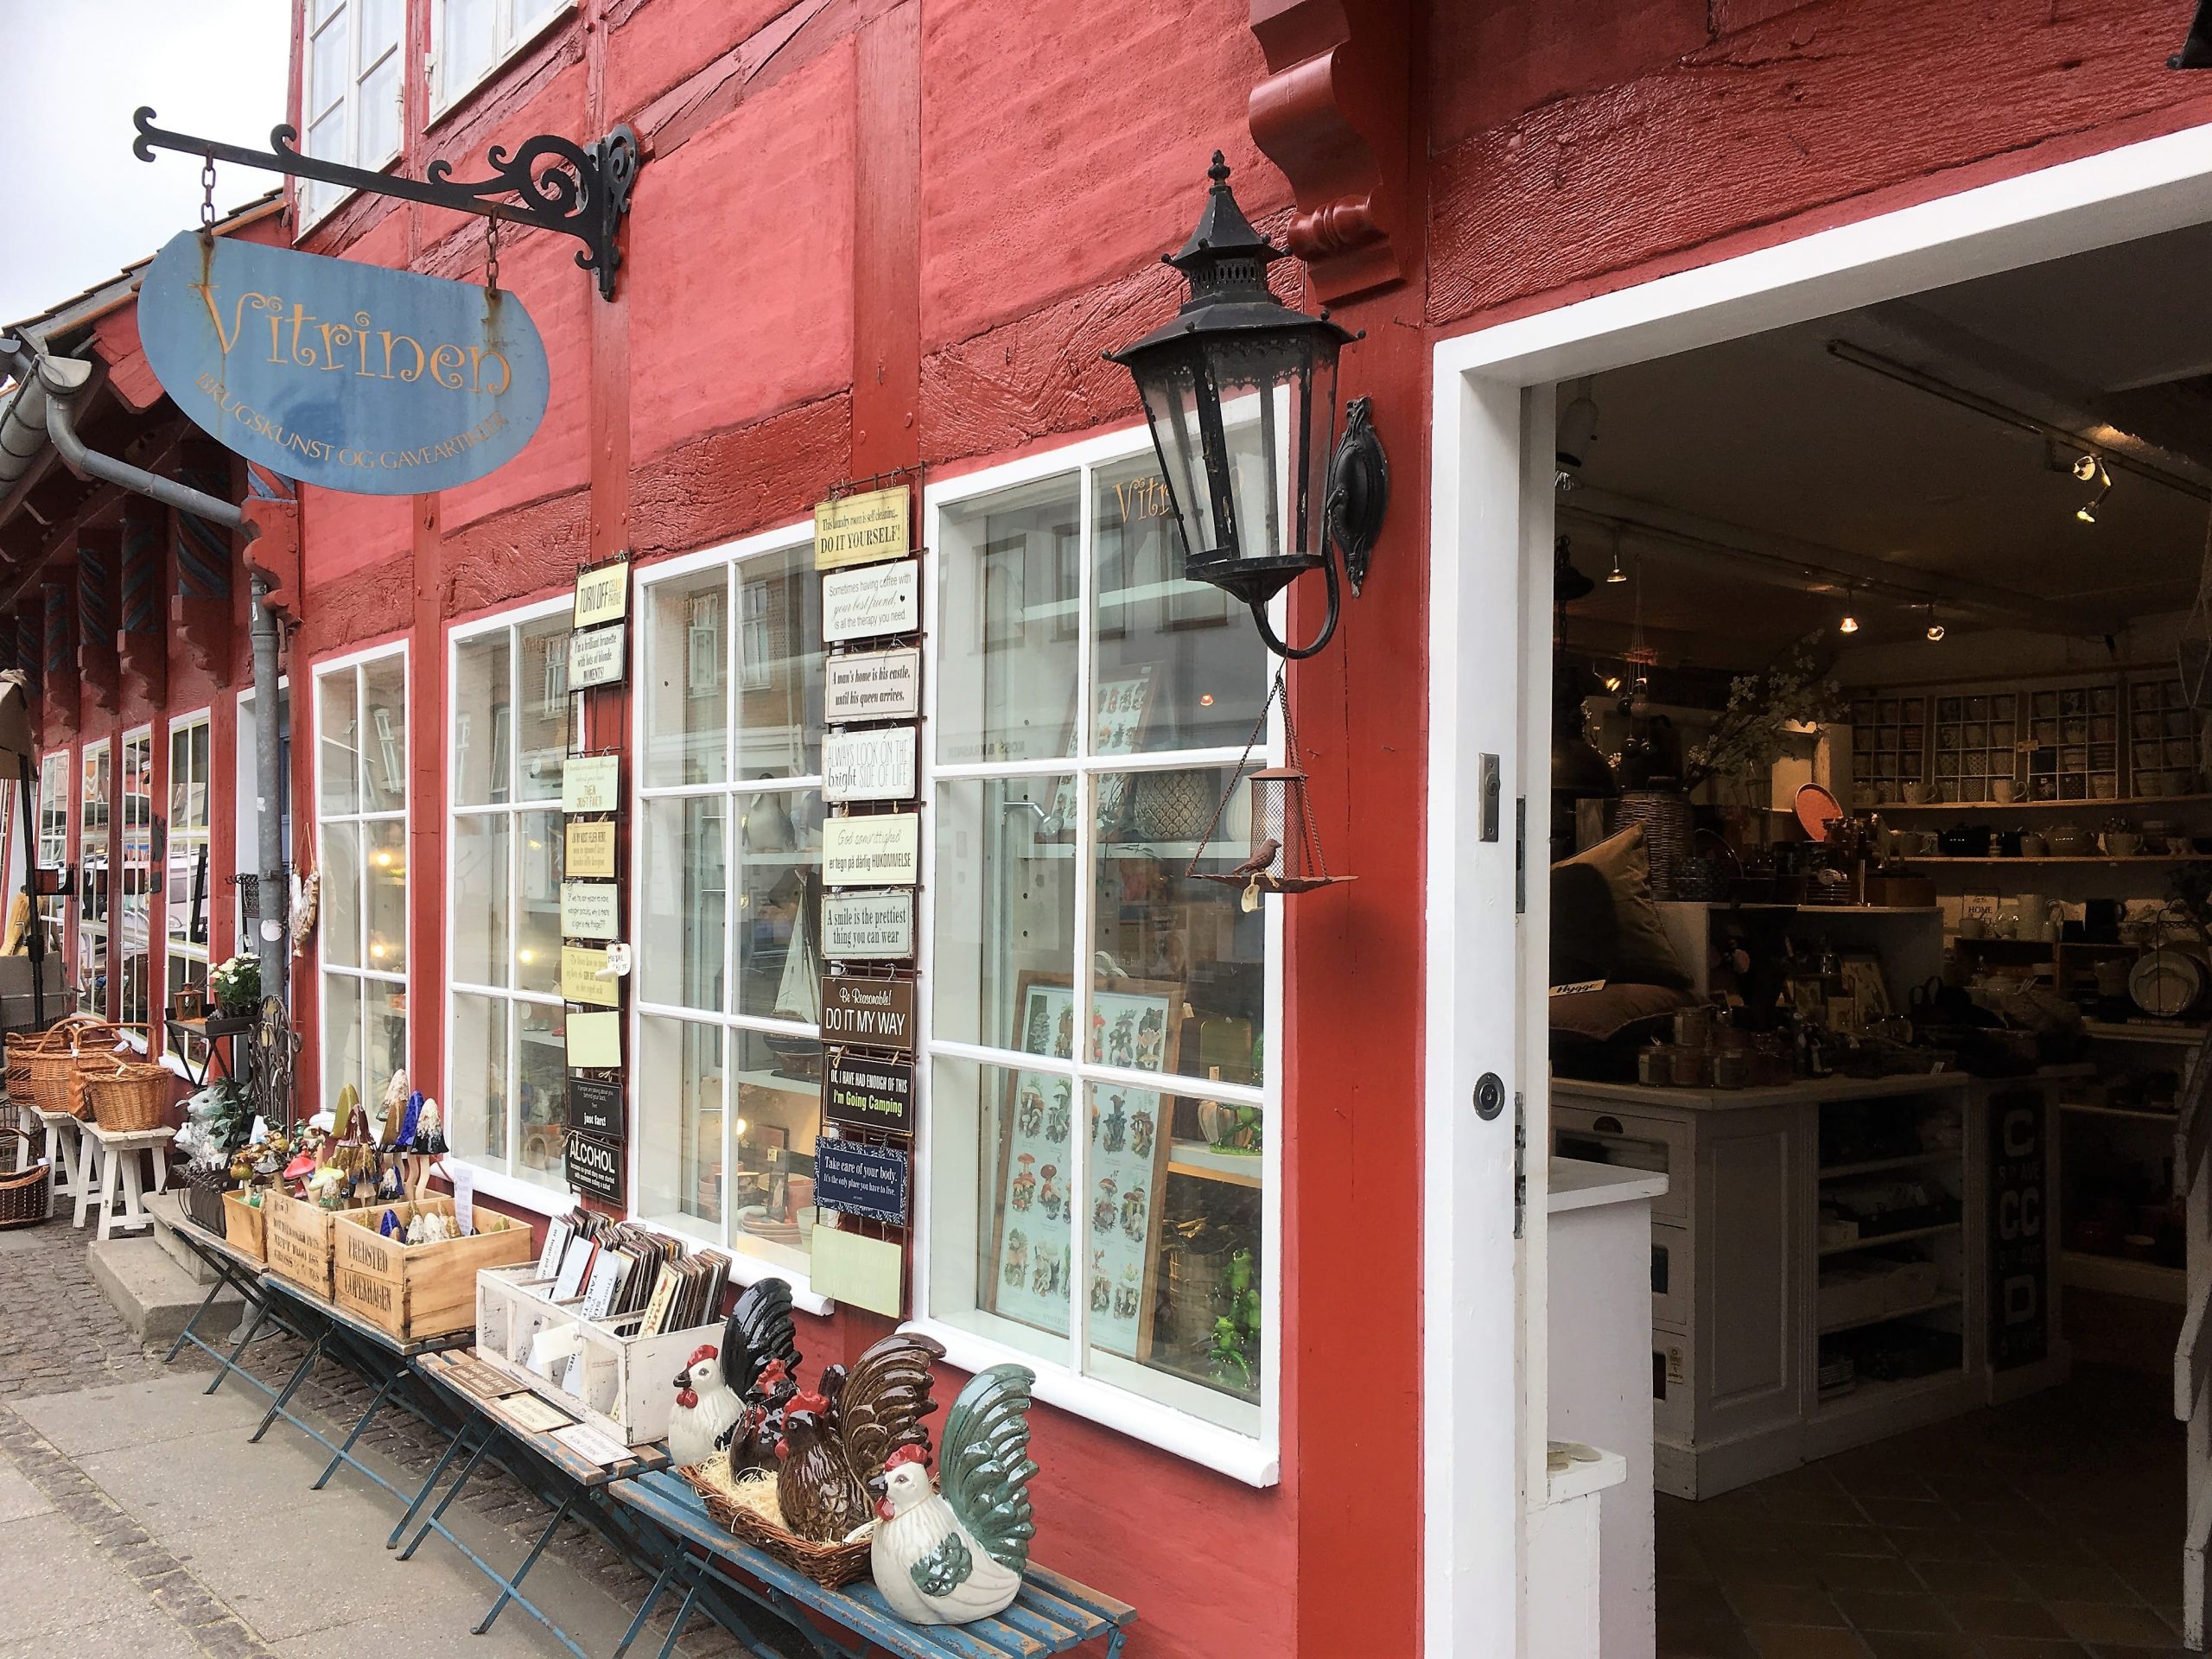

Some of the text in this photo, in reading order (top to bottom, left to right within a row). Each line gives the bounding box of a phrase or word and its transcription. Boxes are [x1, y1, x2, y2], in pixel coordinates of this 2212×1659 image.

[188, 283, 512, 397] Vitrinen
[195, 372, 509, 469] BRUGSKUNST OG GAVEARTIKLER
[867, 512, 876, 523] self
[821, 524, 900, 553] DO IT YOURSELF!
[596, 581, 609, 611] OFF
[830, 573, 911, 597] Sometimes having coffee with
[833, 604, 853, 622] your
[835, 619, 840, 630] is
[847, 616, 856, 628] the
[856, 613, 877, 629] therapy
[879, 613, 890, 626] you
[832, 671, 836, 685] A
[837, 671, 855, 684] man's
[855, 670, 871, 682] home
[872, 668, 877, 681] is
[879, 666, 888, 681] his
[836, 691, 849, 705] until
[850, 690, 859, 704] his
[860, 691, 878, 707] queen
[828, 739, 908, 767] ALWAYS LOOK ON THE
[828, 762, 908, 792] bright SIDE OF LIFE
[837, 830, 901, 852] God samvittighed
[830, 852, 911, 872] er tegn på dårlig HUKOMMELSE
[827, 906, 906, 928] A smile is the prettiest
[833, 928, 899, 948] thing you can wear
[839, 987, 892, 1006] Be Reasonable!
[825, 1007, 906, 1036] DO IT MY WAY
[842, 1070, 855, 1086] HAVE
[855, 1072, 865, 1088] HAD
[866, 1072, 887, 1090] ENOUGH
[888, 1076, 894, 1091] OF
[895, 1077, 907, 1093] THIS
[834, 1089, 903, 1117] I'm Going Camping
[584, 1112, 594, 1126] just
[569, 1139, 615, 1174] ALCOHOL
[824, 1155, 898, 1184] Take care of your body.
[838, 1177, 848, 1188] only
[849, 1178, 860, 1189] place
[860, 1182, 868, 1191] you
[868, 1183, 880, 1192] have
[880, 1185, 886, 1193] to
[886, 1185, 896, 1196] live.
